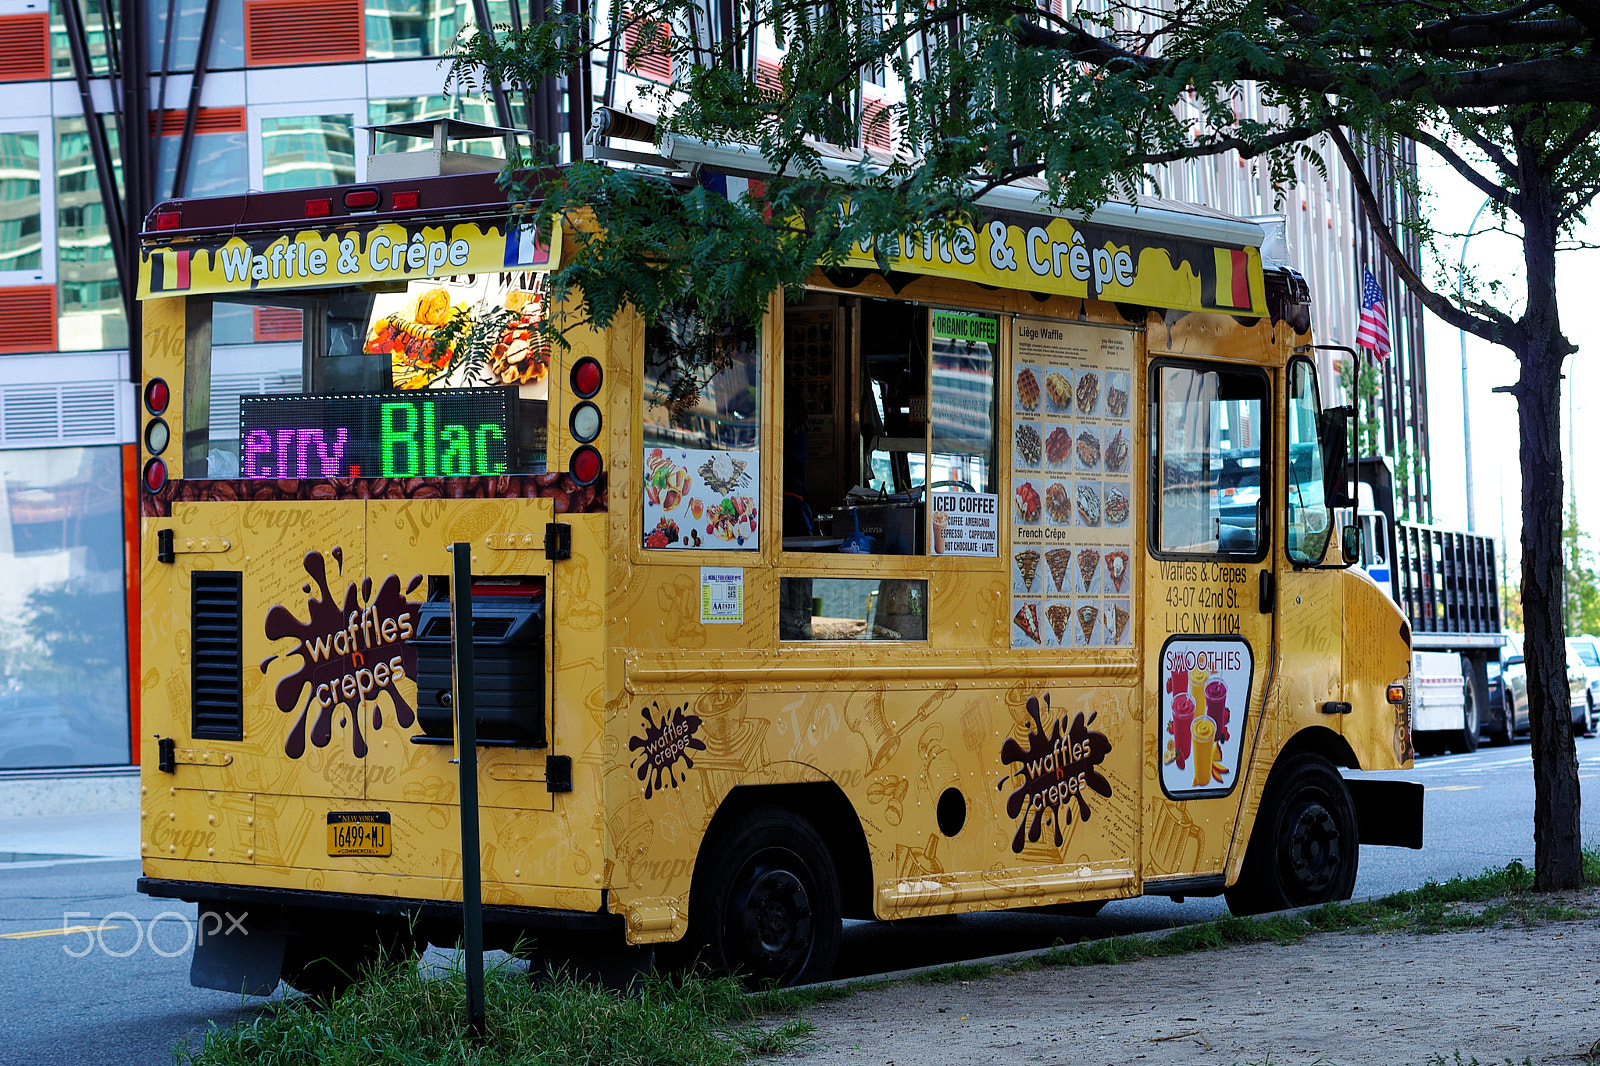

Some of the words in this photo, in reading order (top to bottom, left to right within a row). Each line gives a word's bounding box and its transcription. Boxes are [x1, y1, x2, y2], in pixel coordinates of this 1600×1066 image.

[221, 242, 327, 282] Waffle
[337, 238, 360, 275] &
[369, 232, 469, 276] Crêpe
[989, 220, 1017, 271] &
[1026, 226, 1135, 294] Crêpe
[937, 316, 968, 336] ORGANIC
[969, 320, 995, 339] COFFEE
[1040, 328, 1063, 341] Waffle
[933, 496, 956, 512] ICED
[959, 496, 995, 514] COFFEE
[947, 516, 963, 526] COFFEE
[965, 517, 990, 527] AMERICANO
[940, 528, 963, 539] ESPRESSO
[968, 530, 995, 540] CAPPUCCINO
[1018, 527, 1043, 538] French
[1044, 528, 1066, 541] Crêpe
[945, 541, 953, 551] HOT
[954, 541, 977, 552] CHOCOLATE
[982, 543, 994, 552] LATTE
[1160, 560, 1197, 581] Waffles
[1200, 561, 1208, 582] &
[1211, 562, 1247, 588] Crepes
[1166, 586, 1195, 607] 43-07
[1198, 587, 1224, 608] 42nd
[1226, 588, 1240, 609] St.
[305, 605, 413, 663] waffles
[1165, 613, 1189, 633] L.I.C
[1193, 613, 1209, 633] NY
[1212, 614, 1240, 634] 11104
[352, 651, 365, 668] n
[1166, 651, 1241, 671] SMOOTHIES
[316, 655, 406, 708] crepes
[646, 720, 689, 755] waffles
[654, 734, 690, 765] crepes
[1026, 734, 1092, 780] waffles
[1056, 768, 1064, 780] n
[1033, 771, 1088, 811] crepes
[333, 825, 364, 847] 16499
[371, 825, 384, 847] MJ
